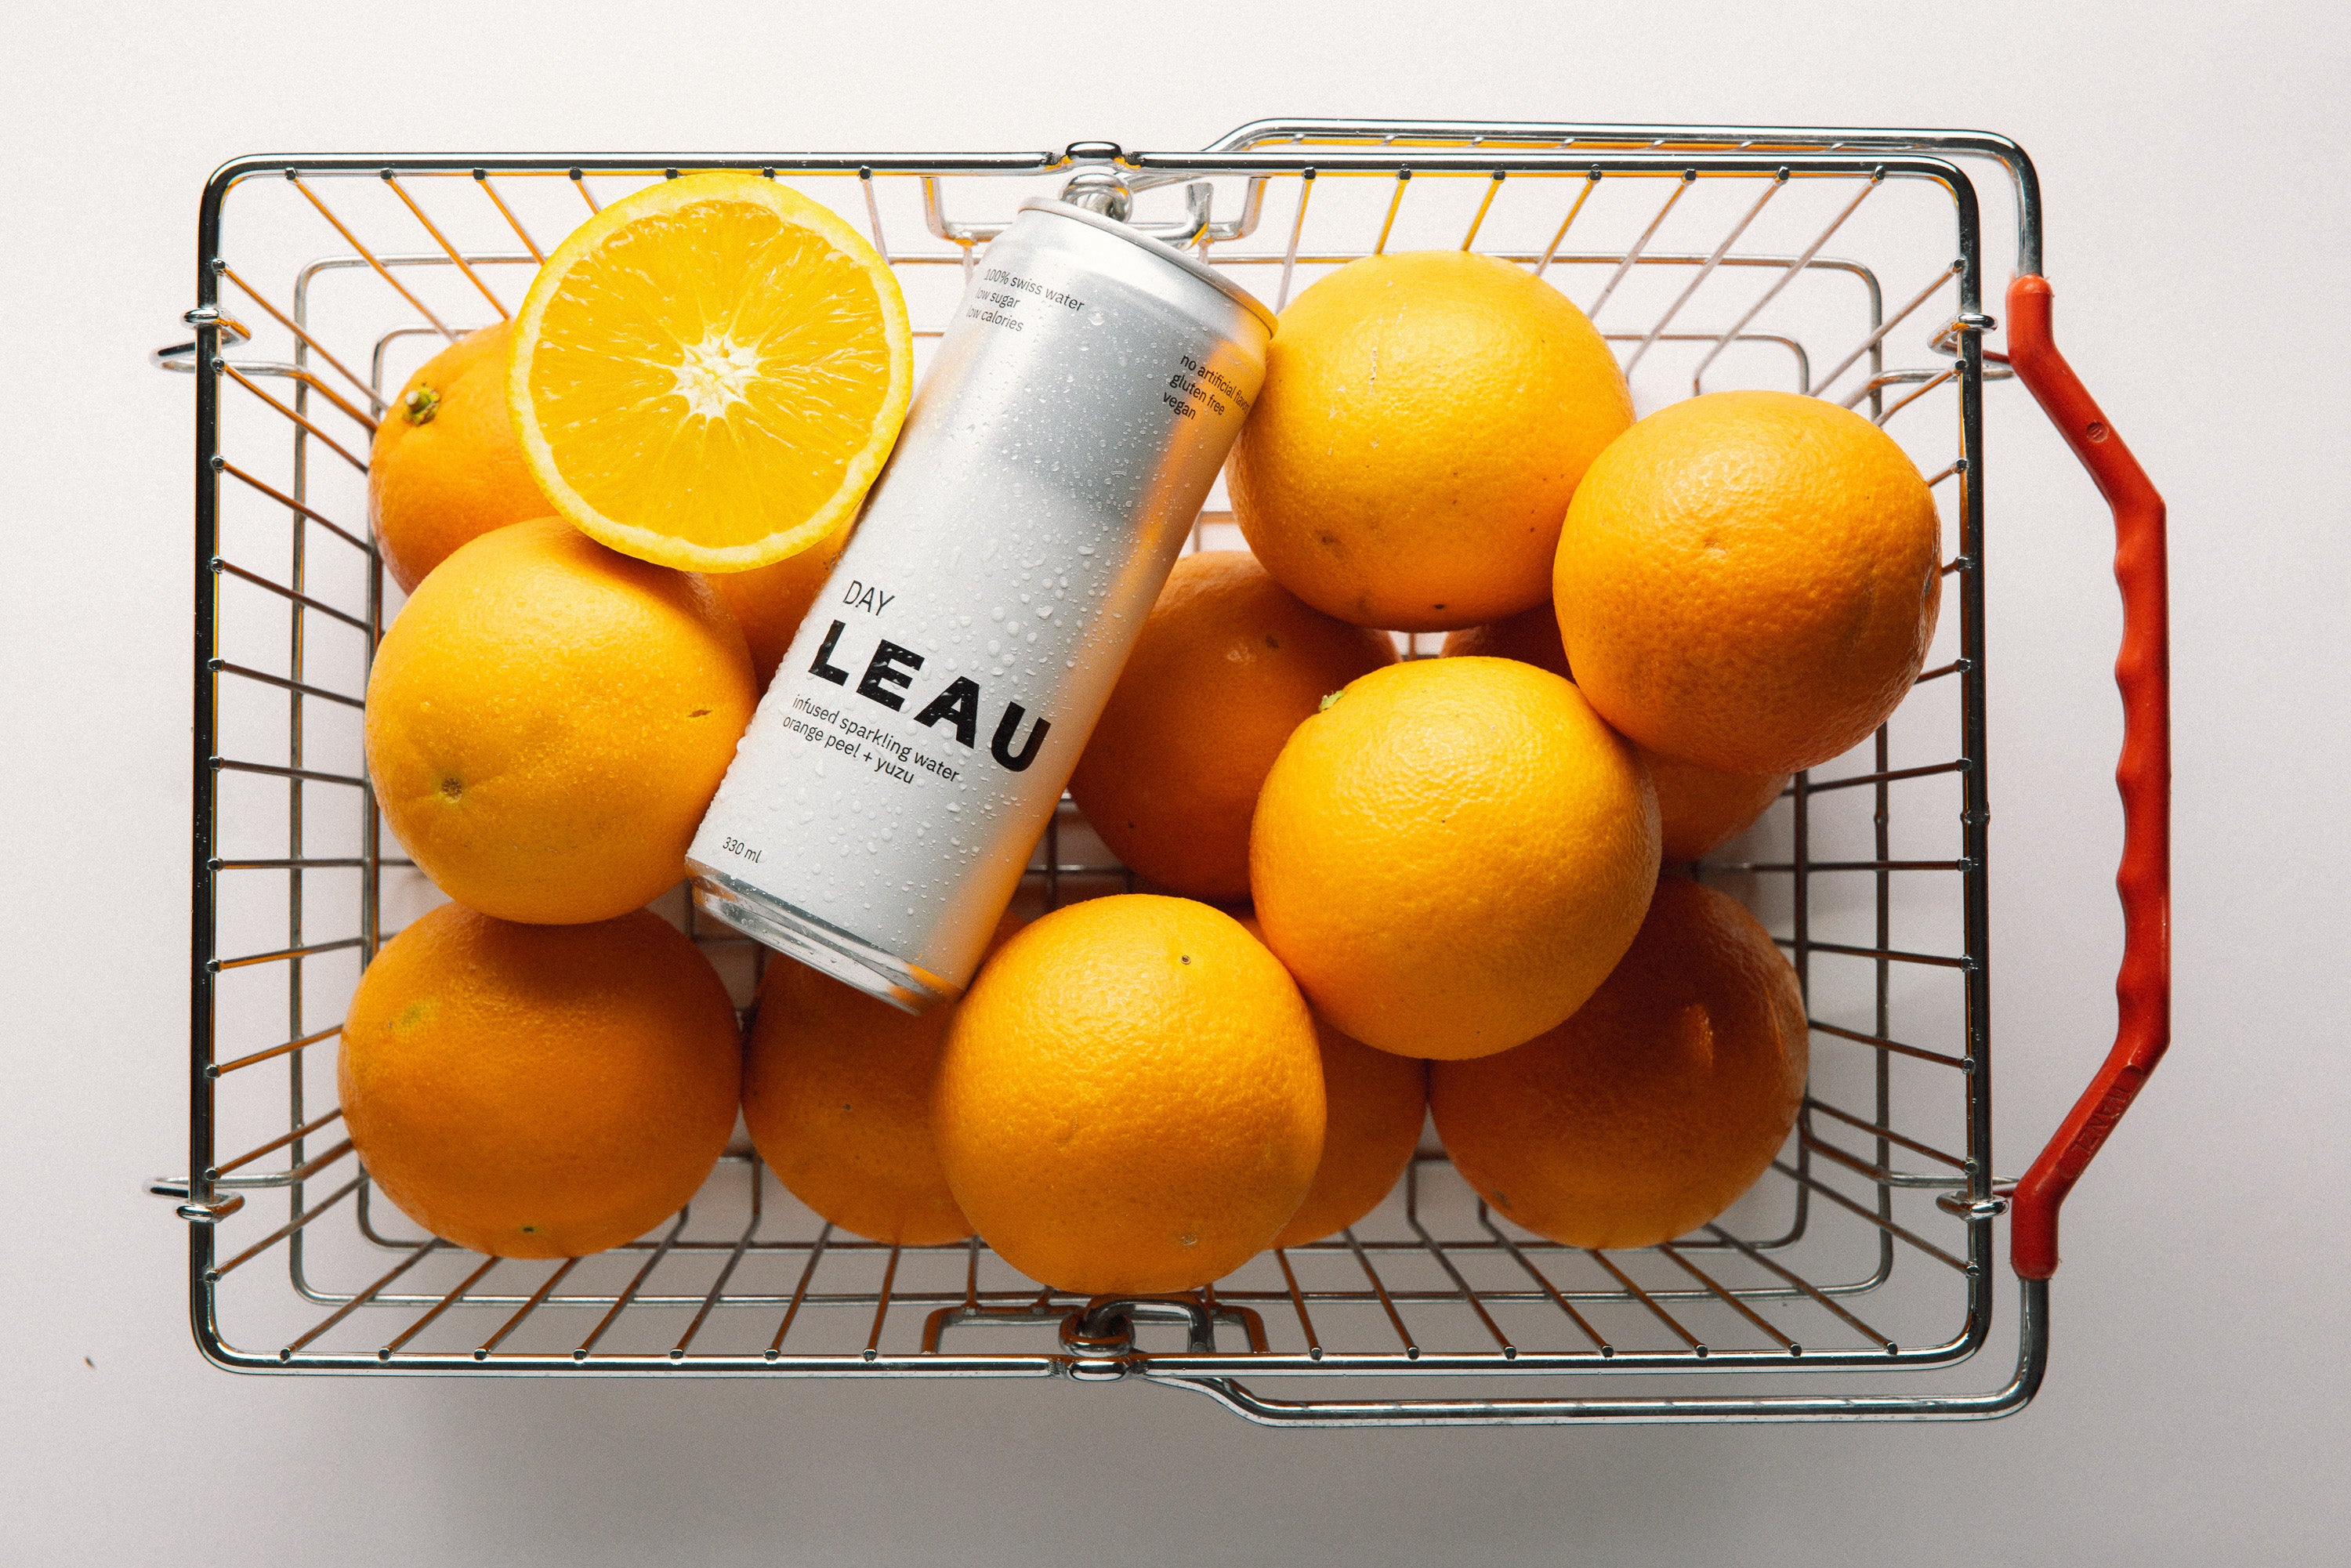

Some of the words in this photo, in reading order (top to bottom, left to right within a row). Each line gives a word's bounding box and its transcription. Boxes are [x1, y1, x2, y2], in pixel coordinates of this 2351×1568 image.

[975, 287, 991, 300] low
[990, 292, 1020, 308] sugar
[984, 269, 1010, 284] 100%
[1010, 277, 1042, 295] swiss
[1045, 288, 1085, 311] water
[966, 305, 981, 319] low
[981, 310, 1024, 331] calories
[1169, 374, 1207, 403] gluten
[1207, 394, 1225, 415] free
[1180, 355, 1197, 371] no
[1197, 366, 1237, 399] artificial
[1163, 392, 1196, 420] vegan
[842, 580, 896, 616] DAY
[808, 619, 1052, 773] LEAU
[783, 715, 824, 741] orange
[824, 734, 861, 759] peel
[875, 757, 915, 784] yuzu
[792, 693, 840, 724] infused
[839, 718, 912, 762] sparkling
[914, 751, 960, 782] water
[723, 836, 744, 855] 330
[744, 846, 763, 864] ml
